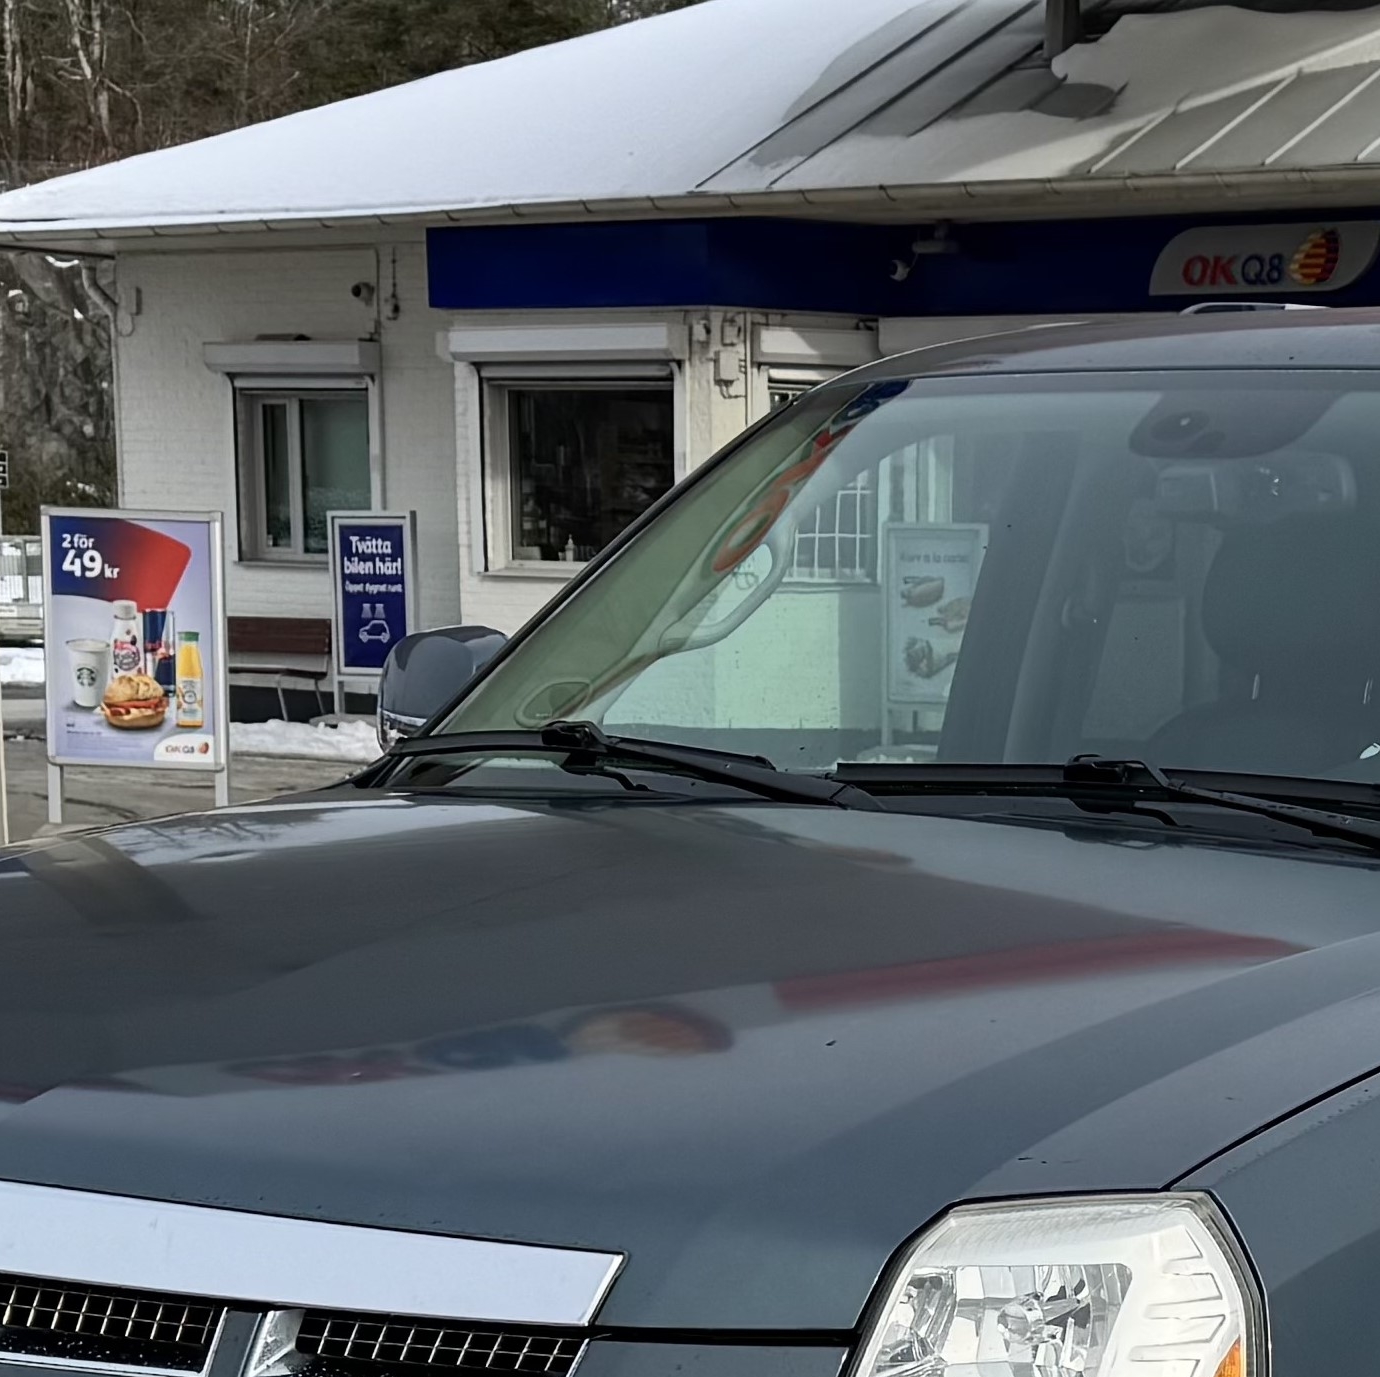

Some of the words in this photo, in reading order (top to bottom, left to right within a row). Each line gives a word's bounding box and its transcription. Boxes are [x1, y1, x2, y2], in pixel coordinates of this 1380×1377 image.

[62, 534, 71, 548] 2
[73, 533, 95, 549] för
[349, 536, 392, 554] Tvätta
[344, 556, 373, 575] bilen
[375, 557, 402, 575] här!
